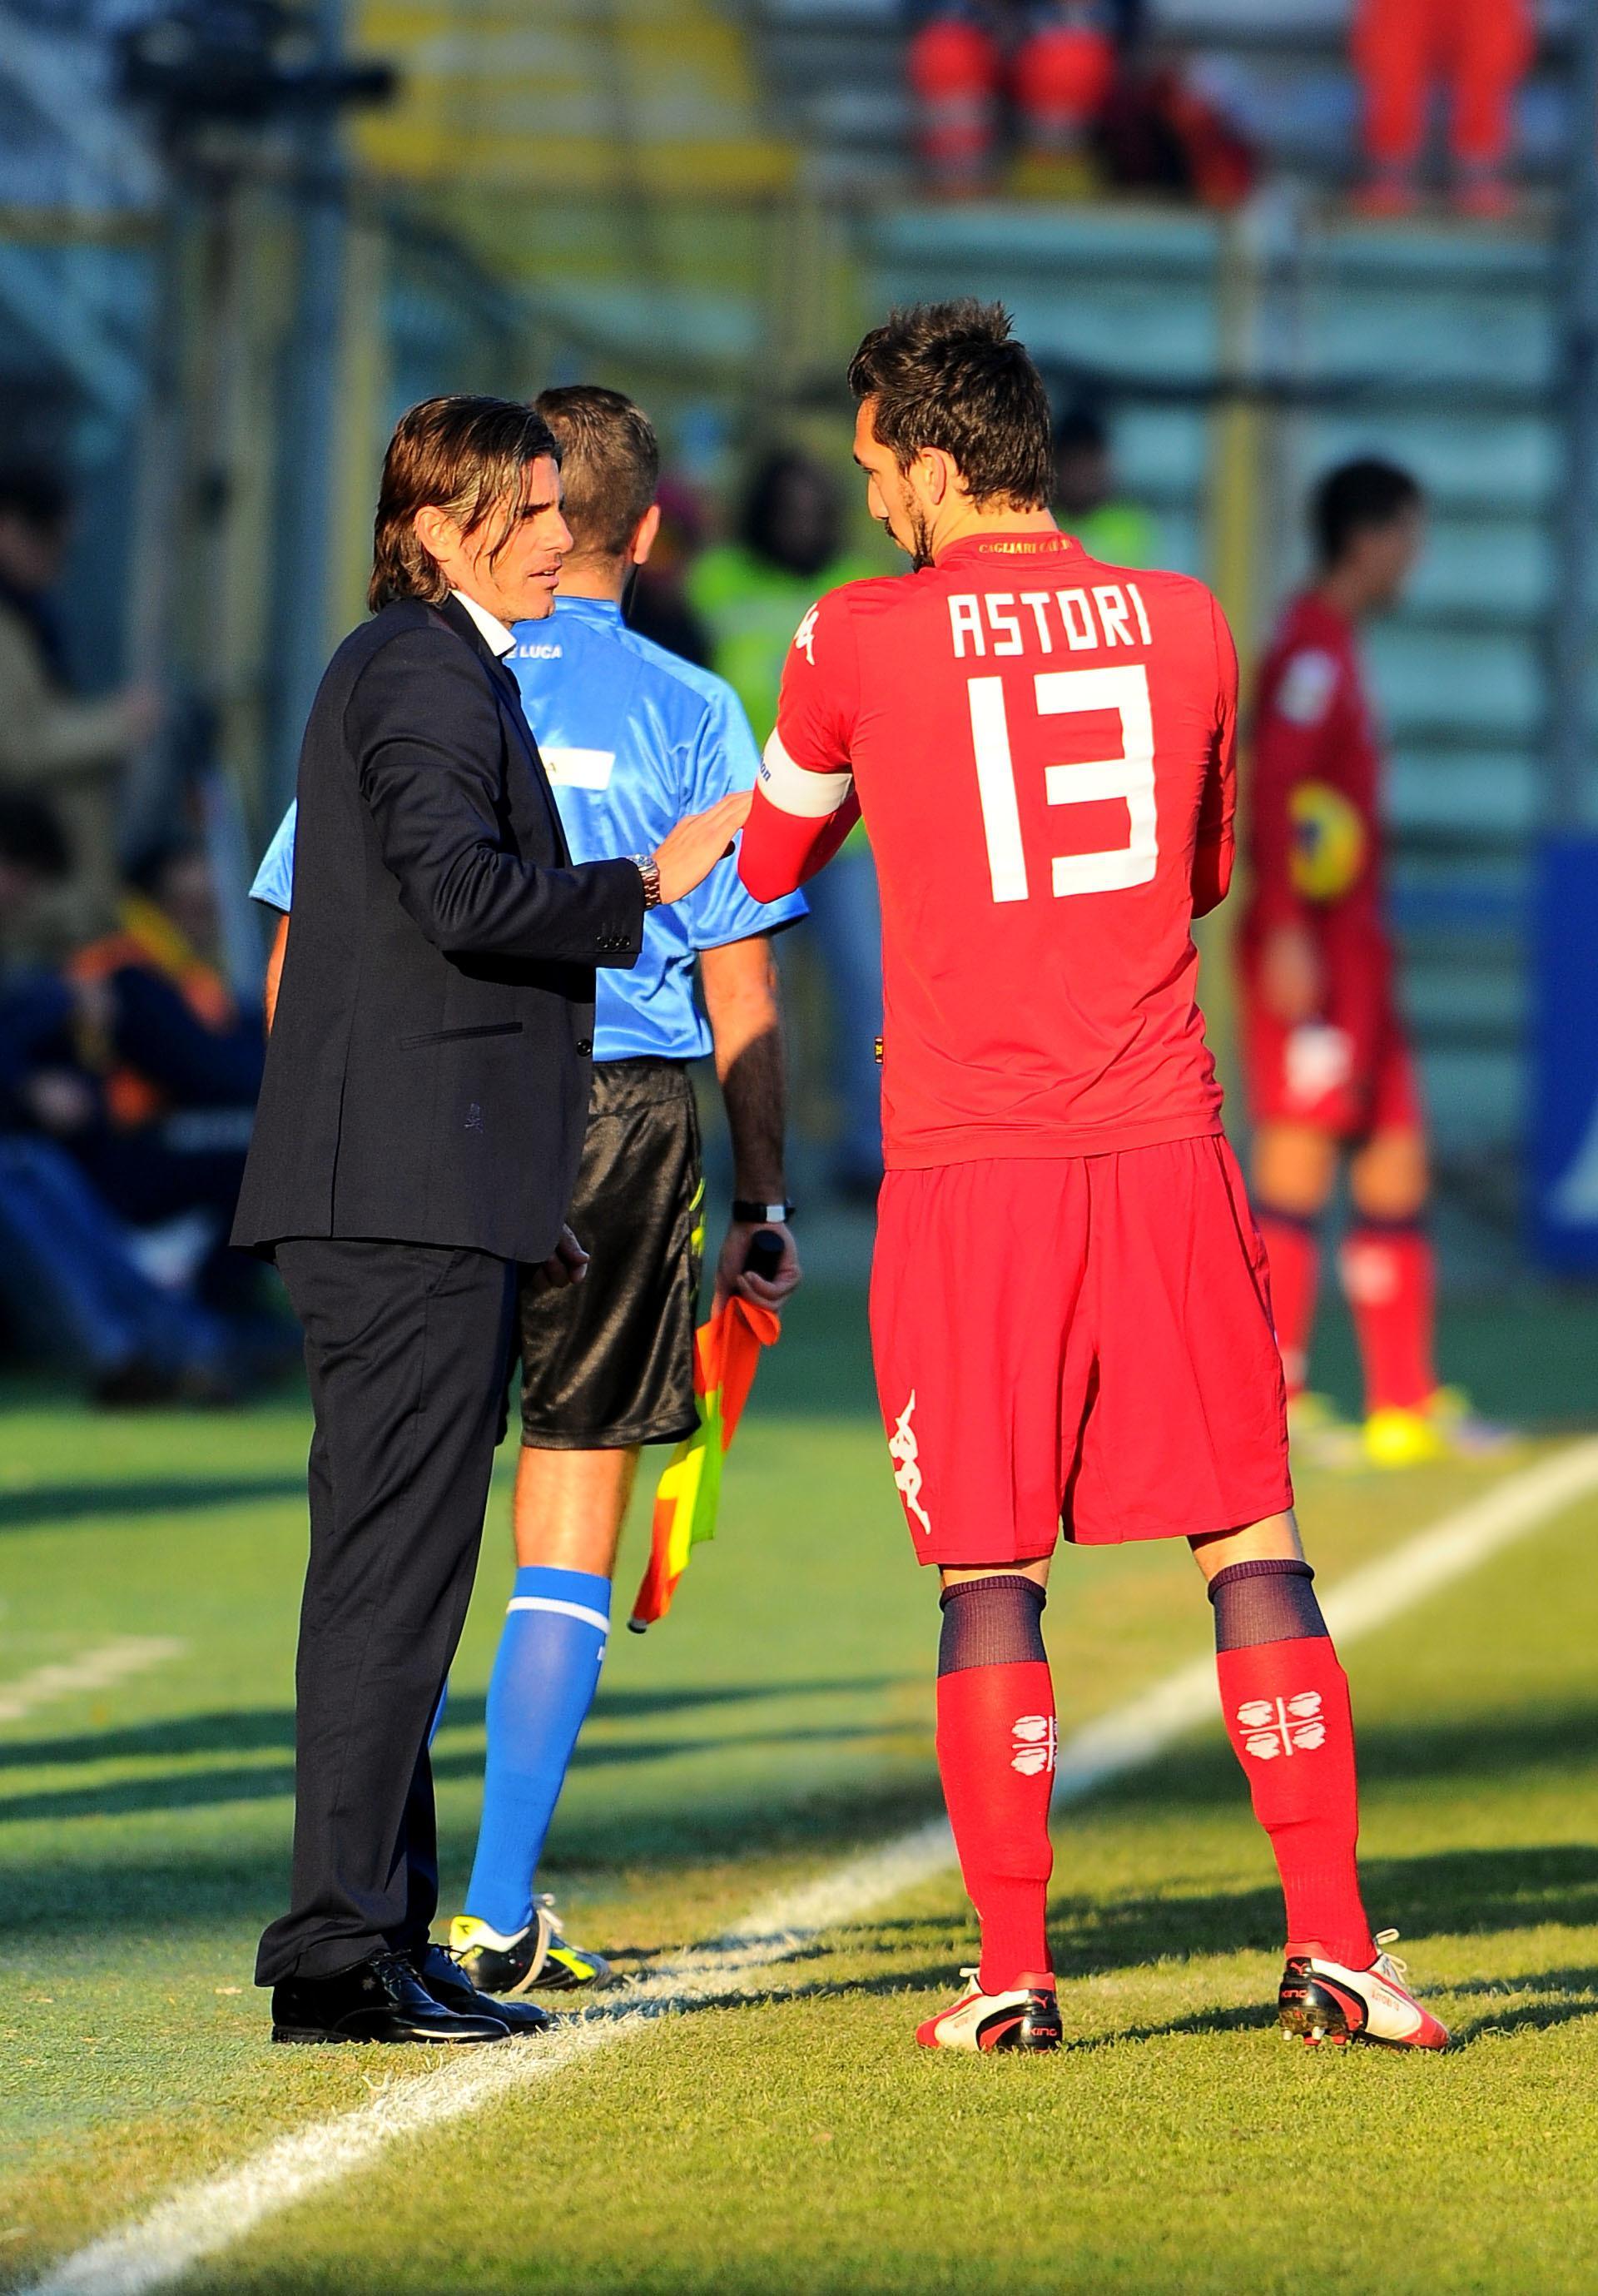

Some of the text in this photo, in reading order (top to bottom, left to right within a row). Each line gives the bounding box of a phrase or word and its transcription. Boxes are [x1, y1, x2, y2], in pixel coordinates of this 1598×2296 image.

[979, 542, 1036, 554] CAGLIARI
[948, 584, 1152, 658] ASTORI
[519, 644, 563, 659] LUCA
[967, 664, 1159, 903] 13
